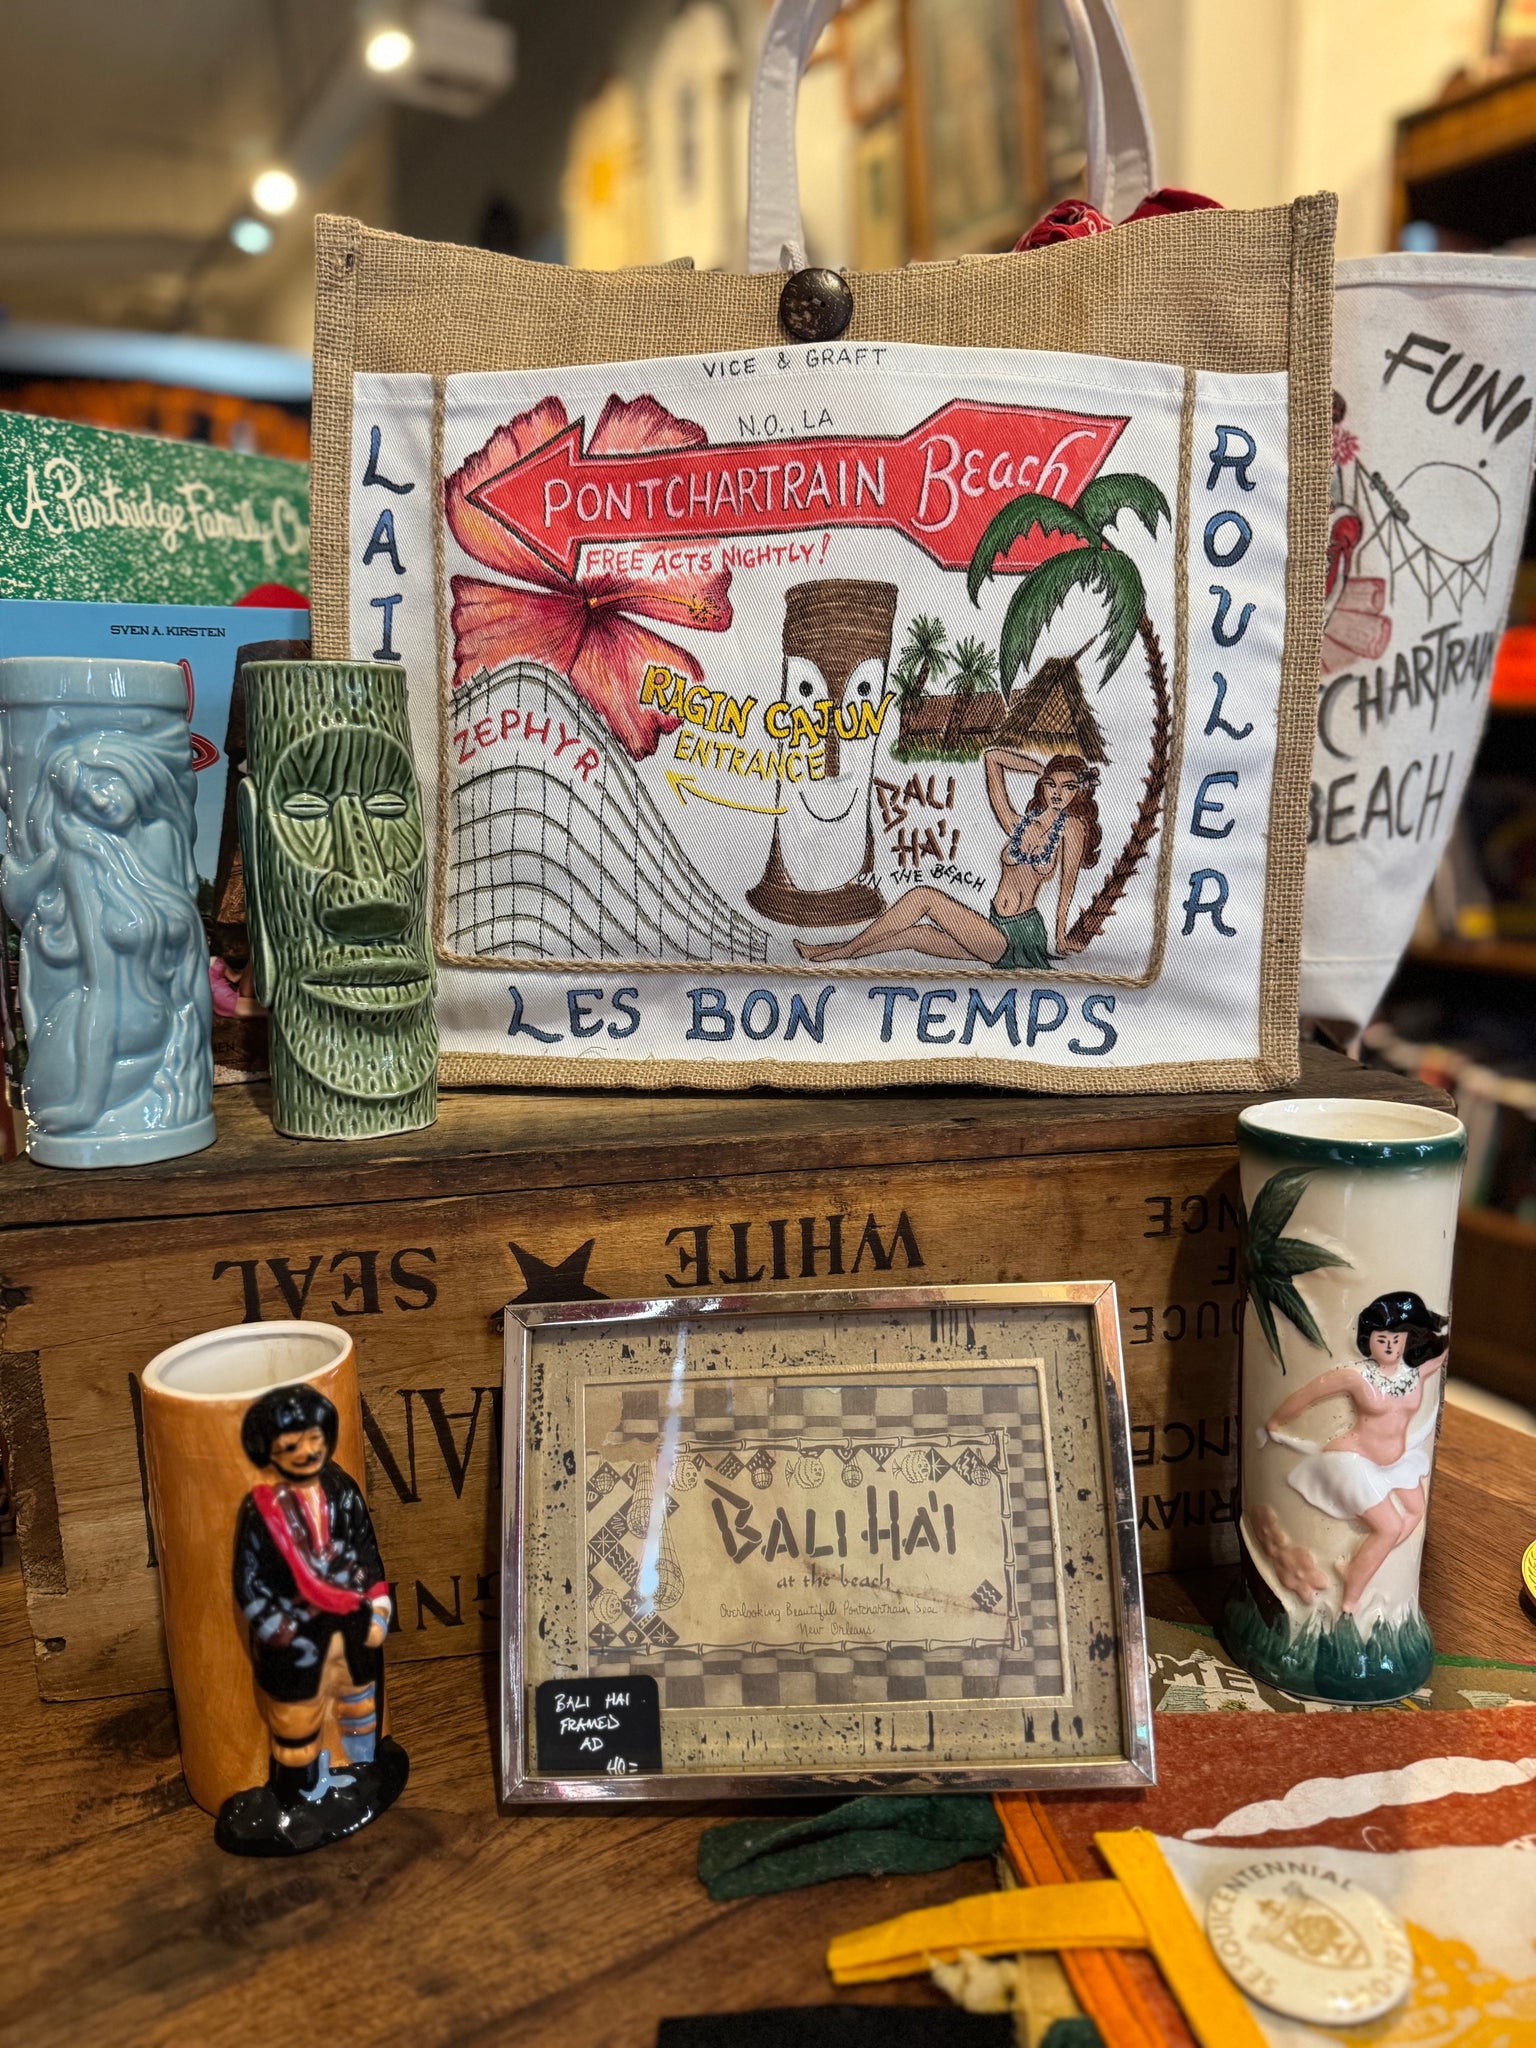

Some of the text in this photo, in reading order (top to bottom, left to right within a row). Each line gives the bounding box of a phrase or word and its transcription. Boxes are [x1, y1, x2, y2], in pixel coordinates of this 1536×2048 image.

[702, 347, 887, 378] VICE & GRAFT
[802, 407, 834, 430] LA
[1381, 332, 1533, 468] FUN!
[6, 463, 63, 535] A
[44, 457, 188, 553] Partridge
[175, 481, 277, 566] Family
[543, 456, 887, 528] PONTCHARTRAIN
[585, 533, 831, 576] FREE ACTS NIGHTLY!
[110, 624, 226, 638] SVEN A. KIRSTEN
[1181, 424, 1257, 939] ROULER
[640, 664, 897, 749] RAGIN CAJUN
[453, 708, 603, 782] ZEPHYR
[673, 731, 829, 783] ENTRANCE
[872, 772, 957, 835] BALI
[889, 868, 924, 885] THE
[930, 863, 987, 892] BEACH
[508, 986, 1119, 1056] LES BON TEMPS
[212, 1209, 925, 1324] WHITE SEAL
[703, 1478, 848, 1565] BALI
[776, 1562, 892, 1589] at the beach
[719, 1602, 782, 1622] Overlooking
[785, 1600, 837, 1621] Beautiful
[842, 1601, 911, 1617] Pontchartrain
[797, 1622, 876, 1636] New Orleans
[554, 1691, 631, 1713] BALI HAI
[559, 1713, 621, 1736] FRAMED
[579, 1736, 605, 1752] AD
